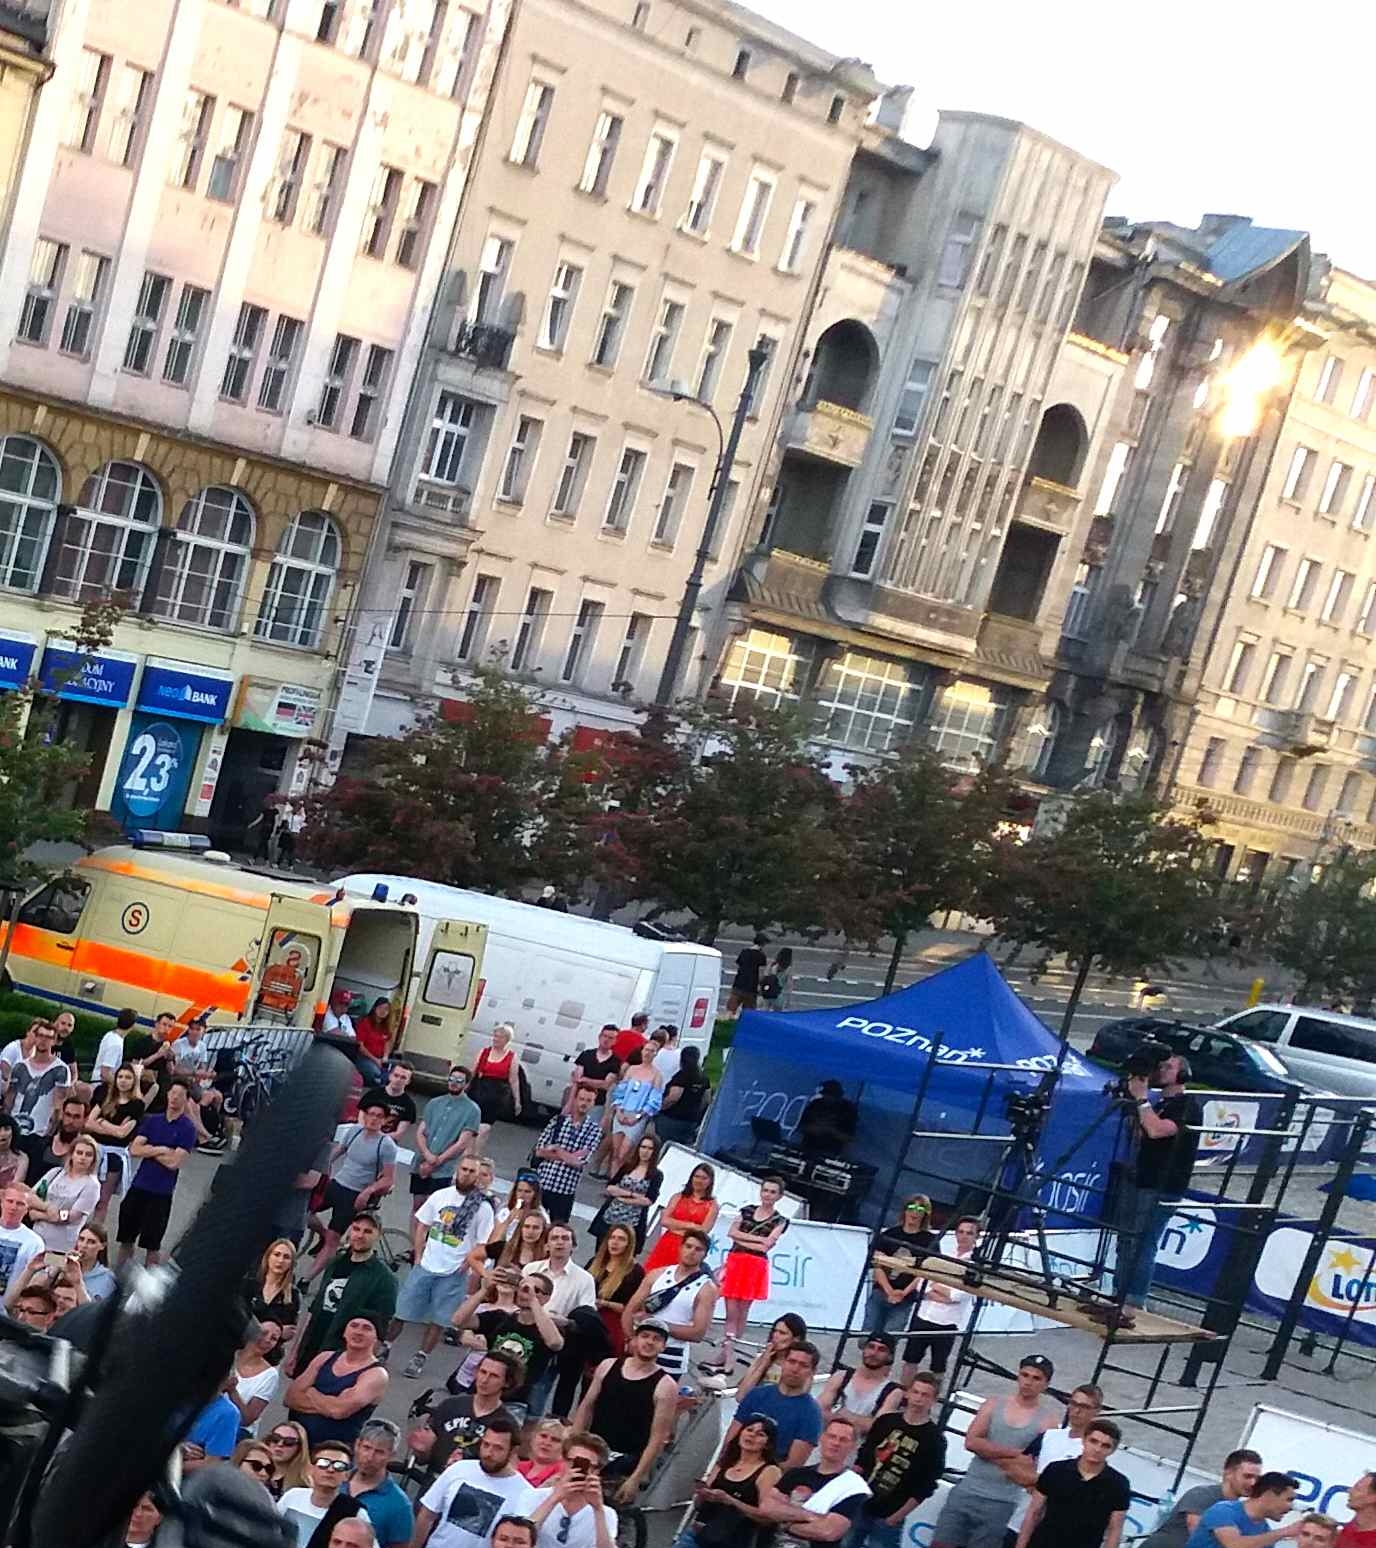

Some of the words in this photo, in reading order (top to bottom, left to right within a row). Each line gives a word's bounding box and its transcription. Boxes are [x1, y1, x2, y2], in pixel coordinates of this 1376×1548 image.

[191, 690, 219, 707] BANK
[129, 909, 142, 928] S
[443, 1416, 471, 1433] EPIC
